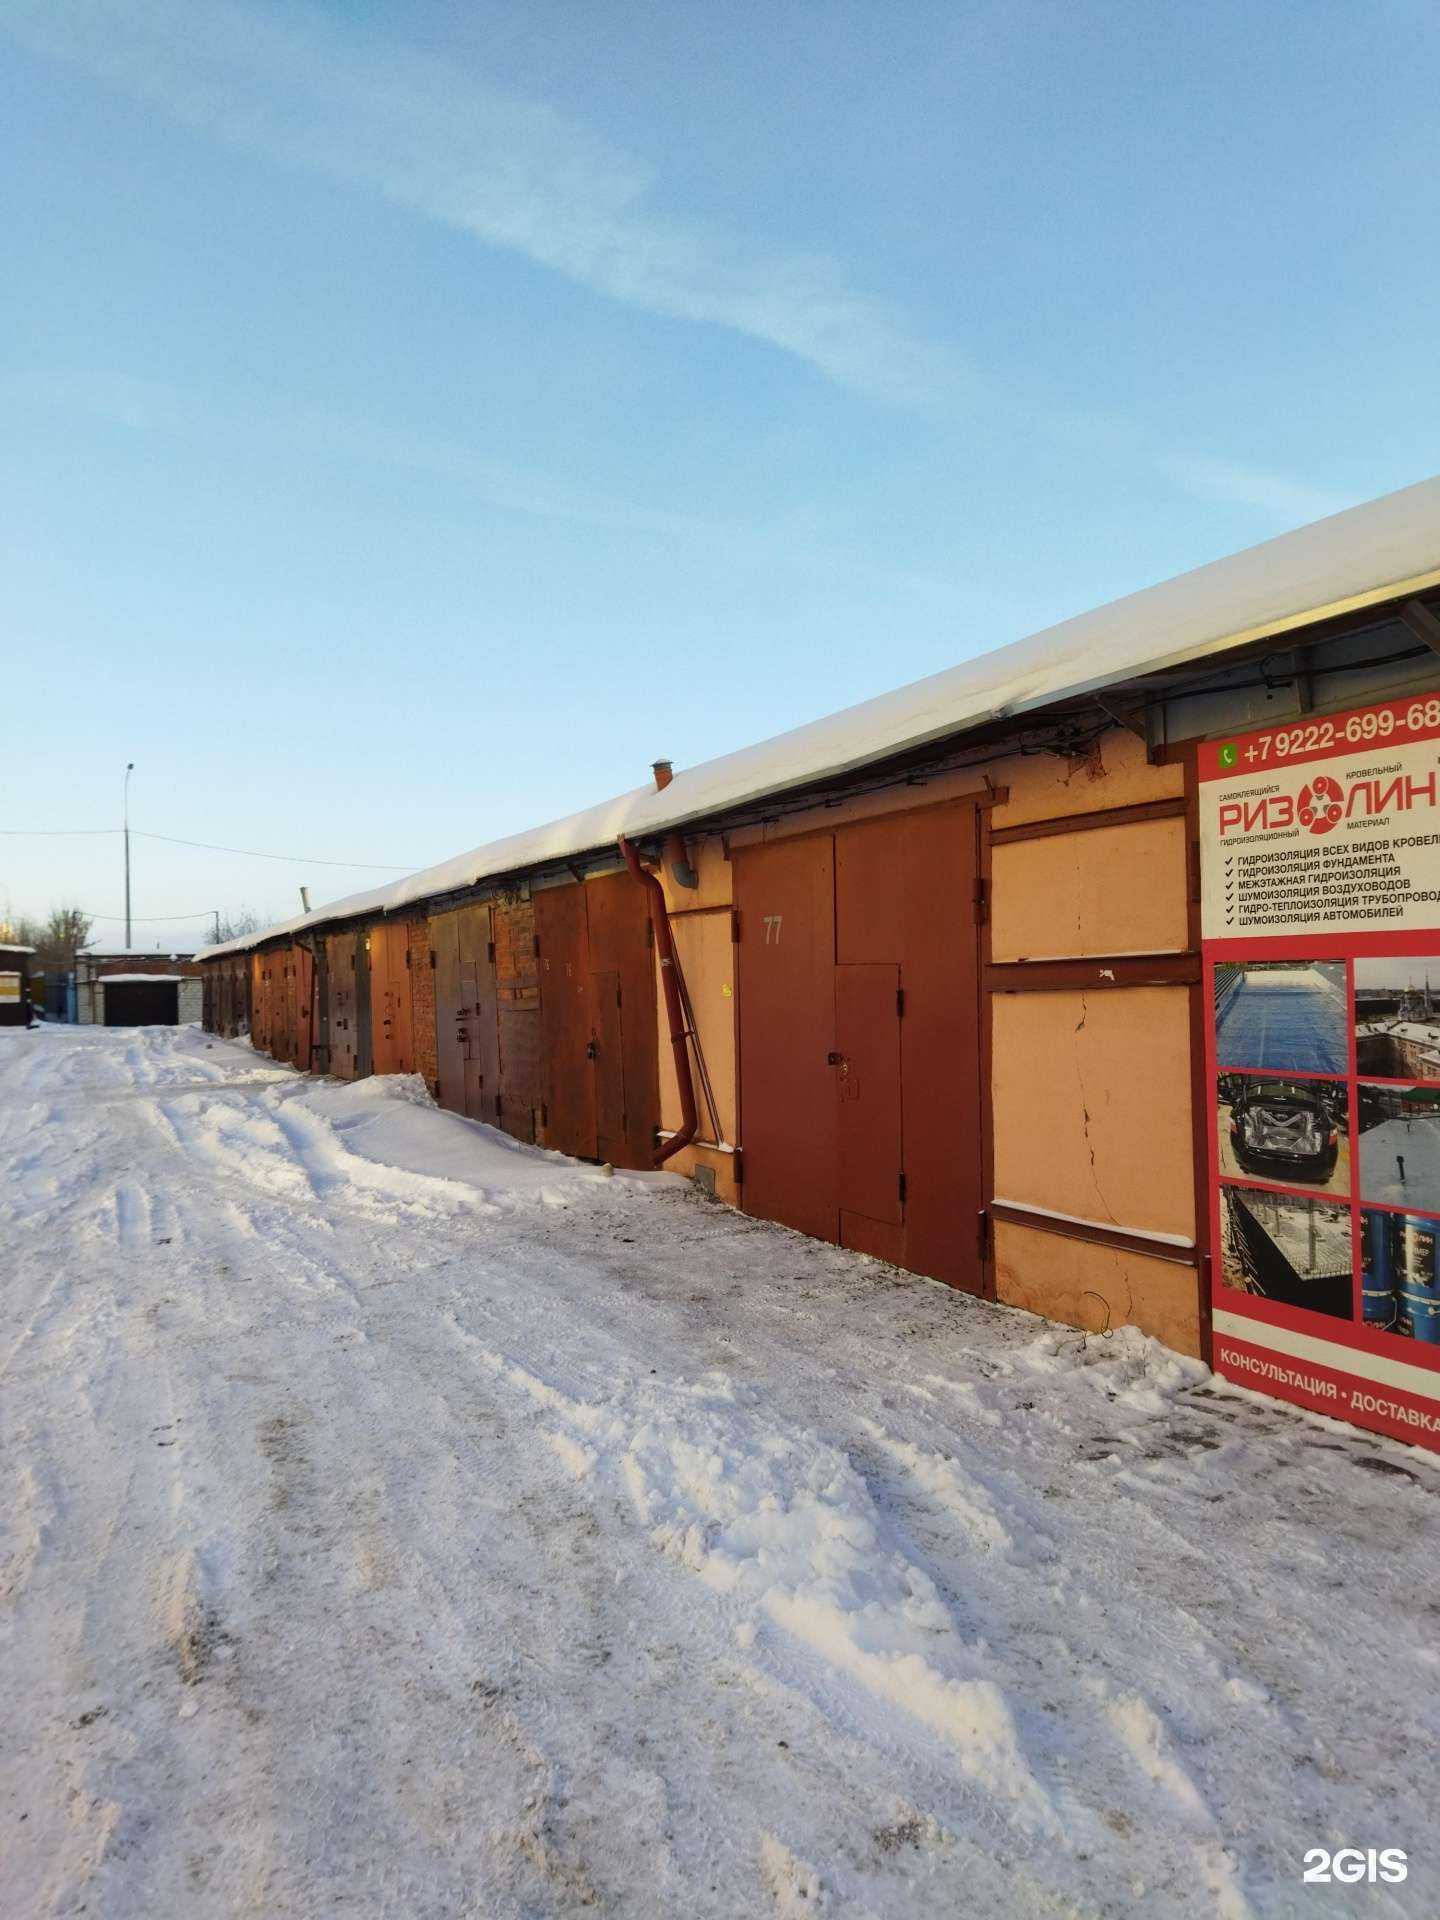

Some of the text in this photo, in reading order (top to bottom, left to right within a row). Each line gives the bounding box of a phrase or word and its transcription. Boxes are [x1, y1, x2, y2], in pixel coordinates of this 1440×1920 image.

[1346, 762, 1402, 780] КРОВЕЛЬНЫЙ
[1219, 784, 1280, 802] САМОКЛЕЯЩИЙСЯ
[1347, 817, 1390, 831] МАТЕРИАЛ
[1220, 828, 1300, 847] ГИДРОИЗОЛЯЦИОННЫЙ
[1237, 834, 1440, 866] ГИДРОИЗОЛЯЦИЯ ВСЕХ ВИДОВ КРОВЕЛ
[1238, 853, 1396, 878] ГИДРОИЗОЛЯЦИЯ ФУНДАМЕНТА
[1238, 866, 1401, 890] МЕЖЭТАЖНАЯ ГИДРОИЗОЛЯЦИЯ
[1238, 879, 1411, 902] ШУМОИЗОЛЯЦИЯ ВОЗДУХОВОДОВ
[1238, 896, 1359, 914] ГИДРО-ТЕПЛОИЗОЛЯЦИЯ
[1239, 905, 1404, 926] ШУМОИЗОЛЯЦИЯ АВТОМОБИЛЕЙ
[763, 915, 783, 945] 77
[1220, 1348, 1440, 1432] КОНСУЛЬТАЦИЯ ДОСТАВКА
